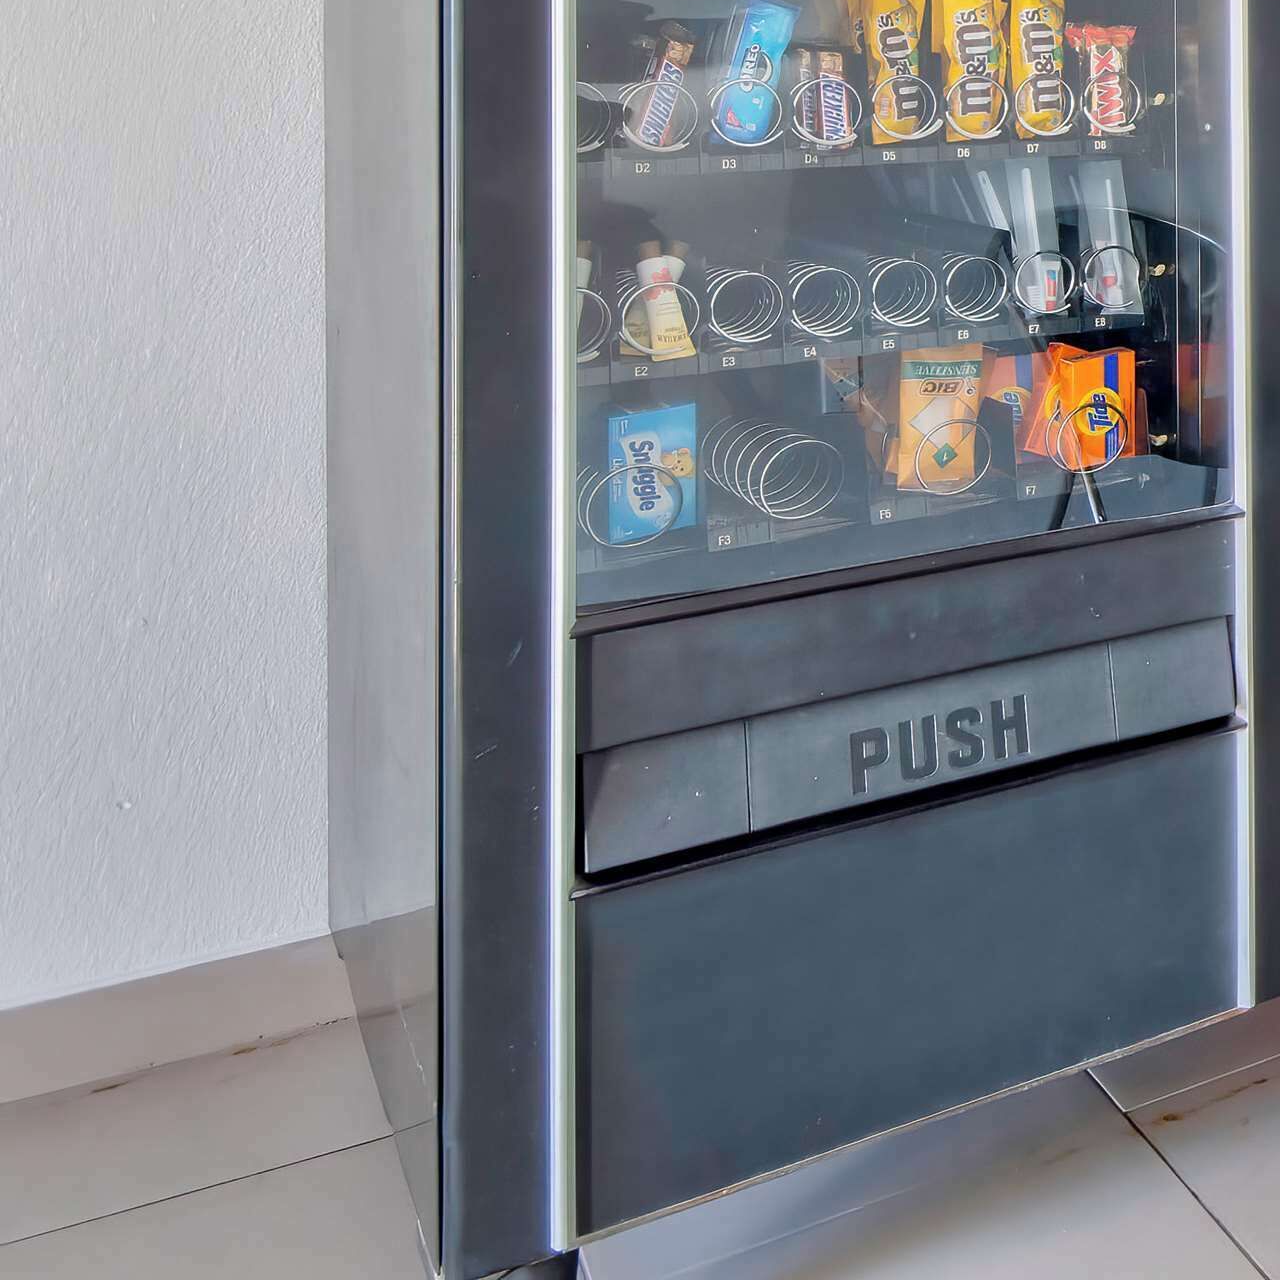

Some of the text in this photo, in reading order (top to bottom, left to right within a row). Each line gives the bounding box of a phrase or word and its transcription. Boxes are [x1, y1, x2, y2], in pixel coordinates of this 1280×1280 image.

[739, 43, 762, 93] OREO
[640, 60, 684, 146] SNICKERS
[1027, 143, 1039, 153] D7
[1094, 140, 1106, 150] D8
[883, 151, 896, 161] D5
[957, 147, 970, 158] D6
[805, 153, 818, 164] D4
[635, 162, 650, 173] D2
[722, 159, 737, 169] D3
[1095, 317, 1106, 327] E8
[1028, 324, 1040, 334] E7
[957, 330, 969, 339] E6
[883, 339, 895, 350] E5
[804, 347, 817, 357] E4
[722, 357, 735, 367] E3
[634, 367, 648, 377] E2
[914, 363, 978, 376] SENSITIVE
[921, 380, 960, 396] BIC
[1086, 392, 1115, 433] Tide
[628, 440, 662, 512] Snuggle
[1025, 485, 1037, 496] F7
[879, 510, 892, 519] F5
[718, 535, 731, 545] F3
[849, 693, 1032, 796] PUSH
